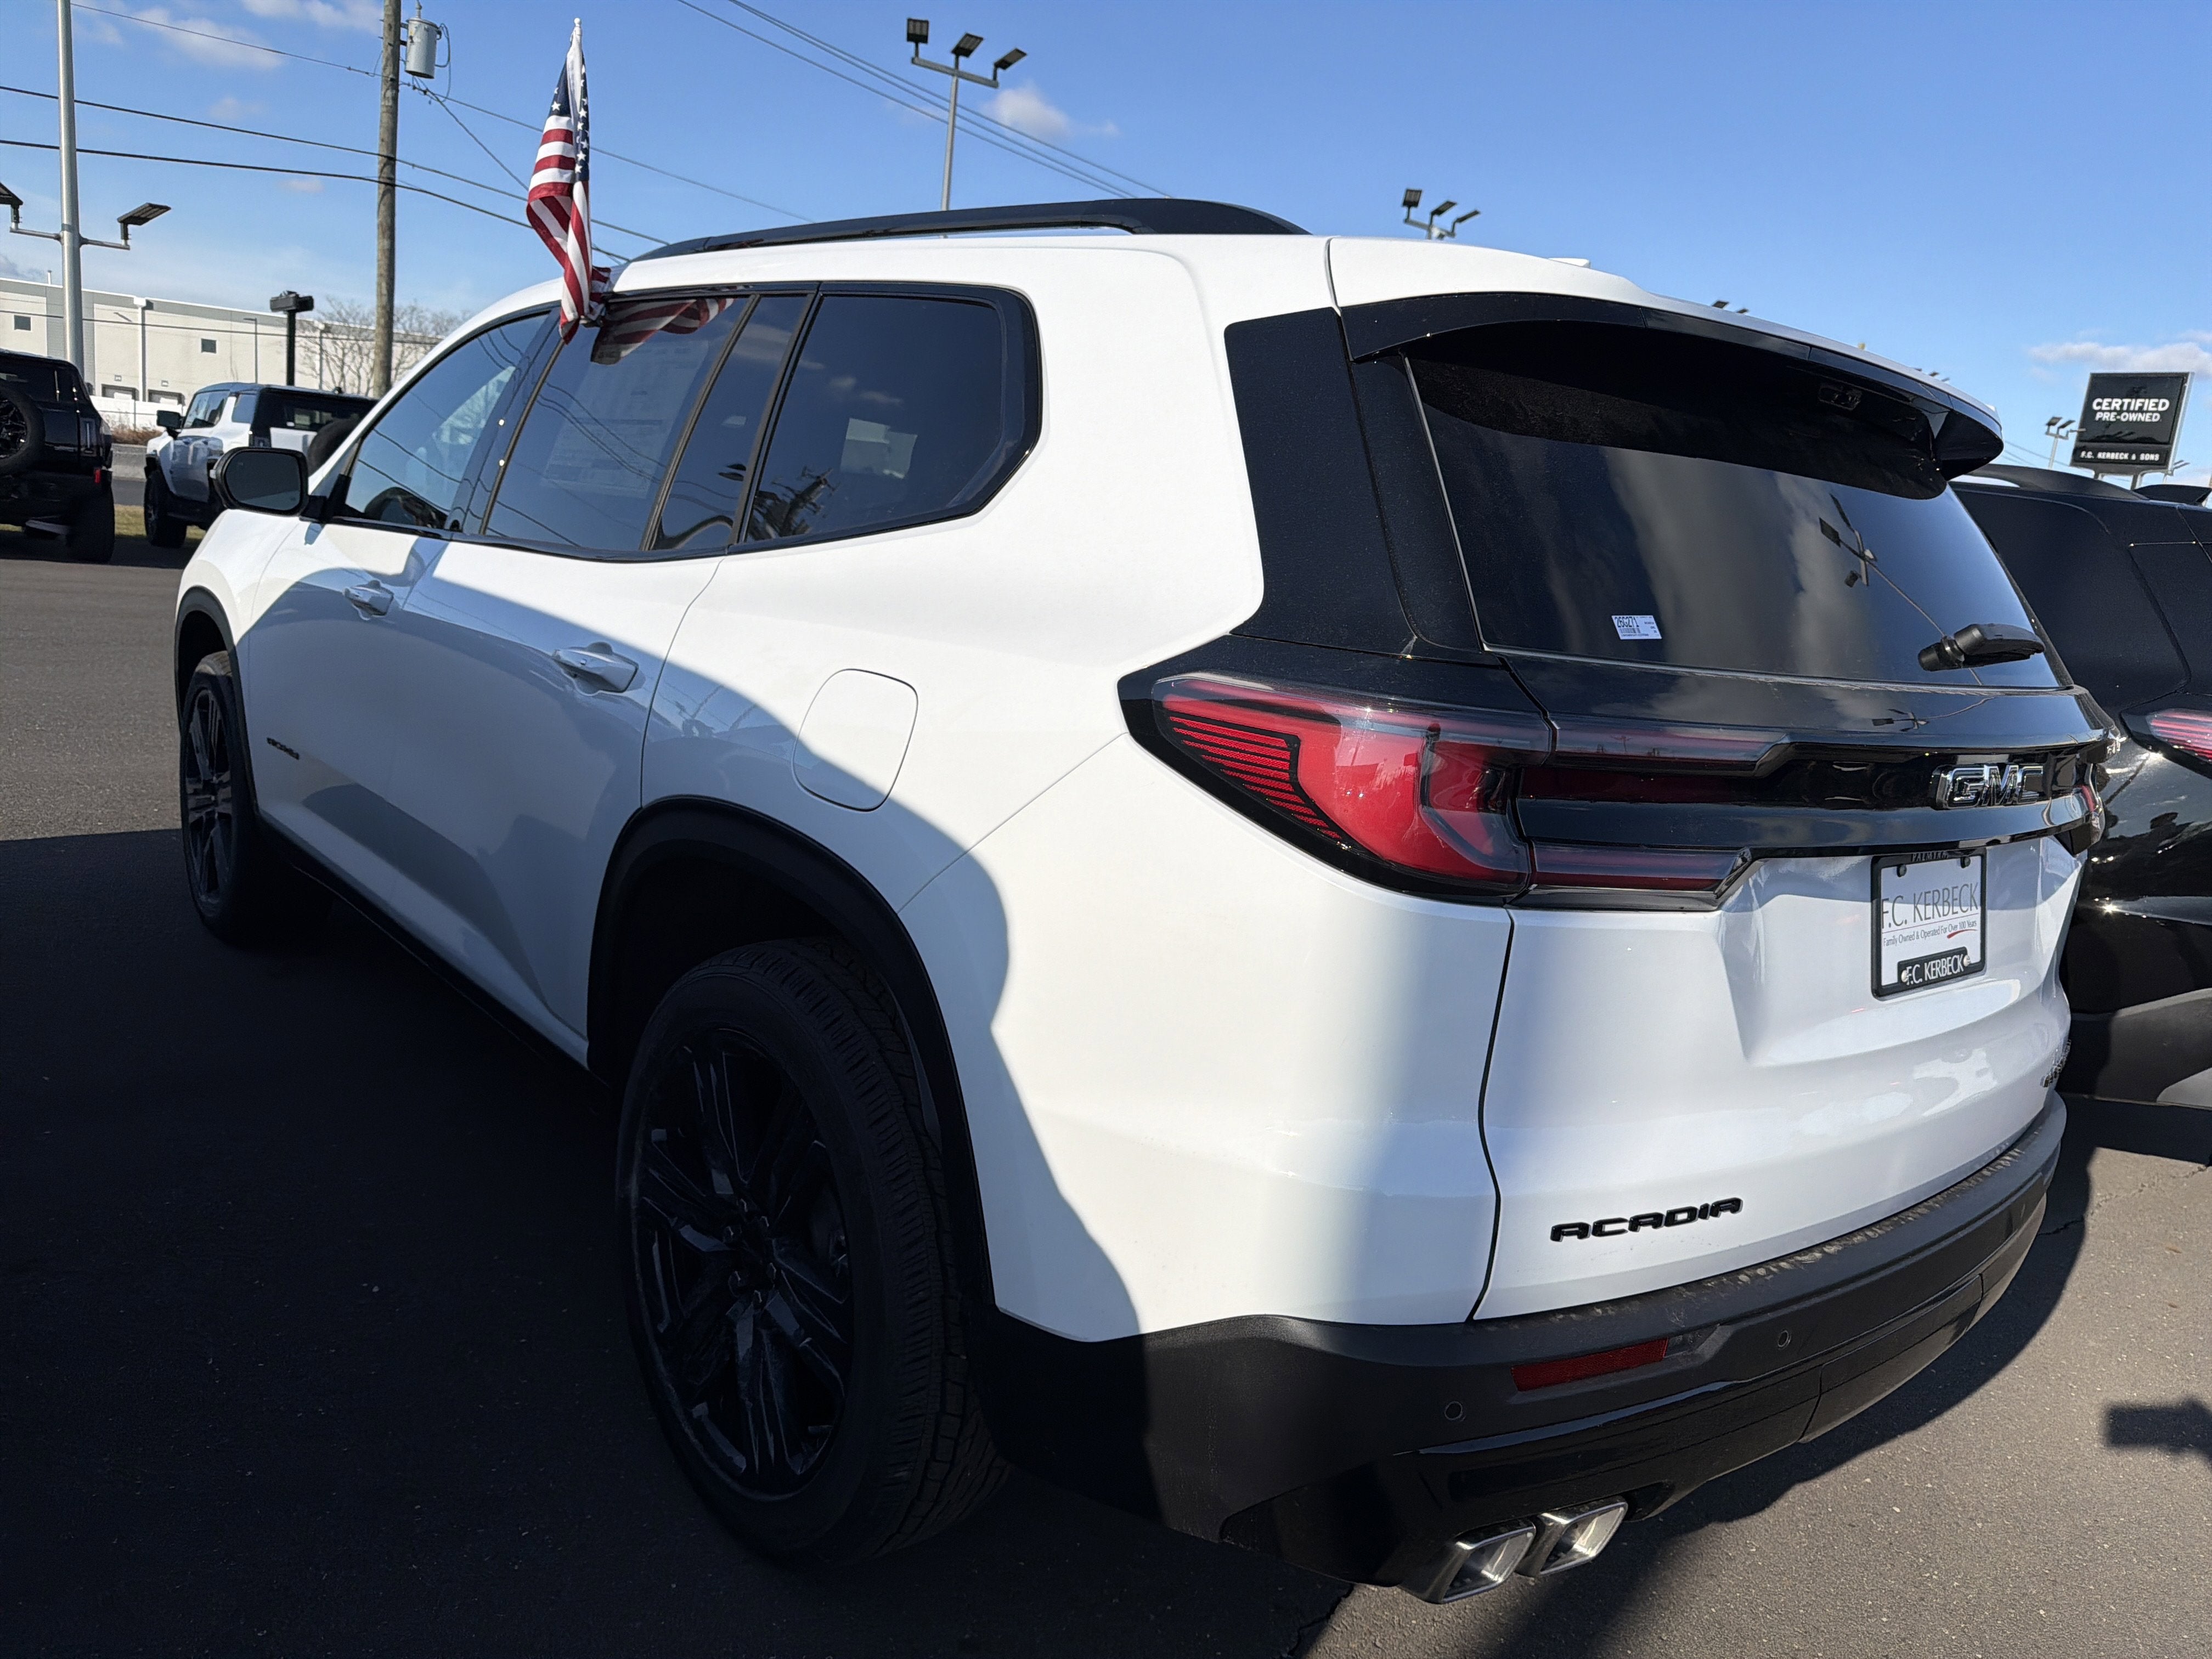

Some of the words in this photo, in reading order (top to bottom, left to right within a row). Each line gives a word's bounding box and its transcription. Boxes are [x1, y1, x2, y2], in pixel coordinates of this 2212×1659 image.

[2092, 398, 2170, 411] CERTIFIED
[2095, 412, 2160, 422] PRE-OWNED
[2080, 450, 2095, 459] F.C.
[2096, 452, 2129, 460] KERBECK
[2140, 453, 2160, 461] SONS
[1933, 764, 2044, 810] GMC
[1881, 895, 1908, 929] F.C.
[1913, 882, 1979, 924] KERBECK
[1883, 935, 1898, 947] Family
[1898, 933, 1915, 944] Owned
[1916, 932, 1920, 940] &
[1920, 926, 1940, 940] Operated
[1948, 923, 1959, 933] Over
[1967, 919, 1977, 929] Years
[1906, 964, 1923, 986] F.C.
[1924, 953, 1964, 981] KERBECK
[1550, 1197, 1743, 1242] ACADIA
